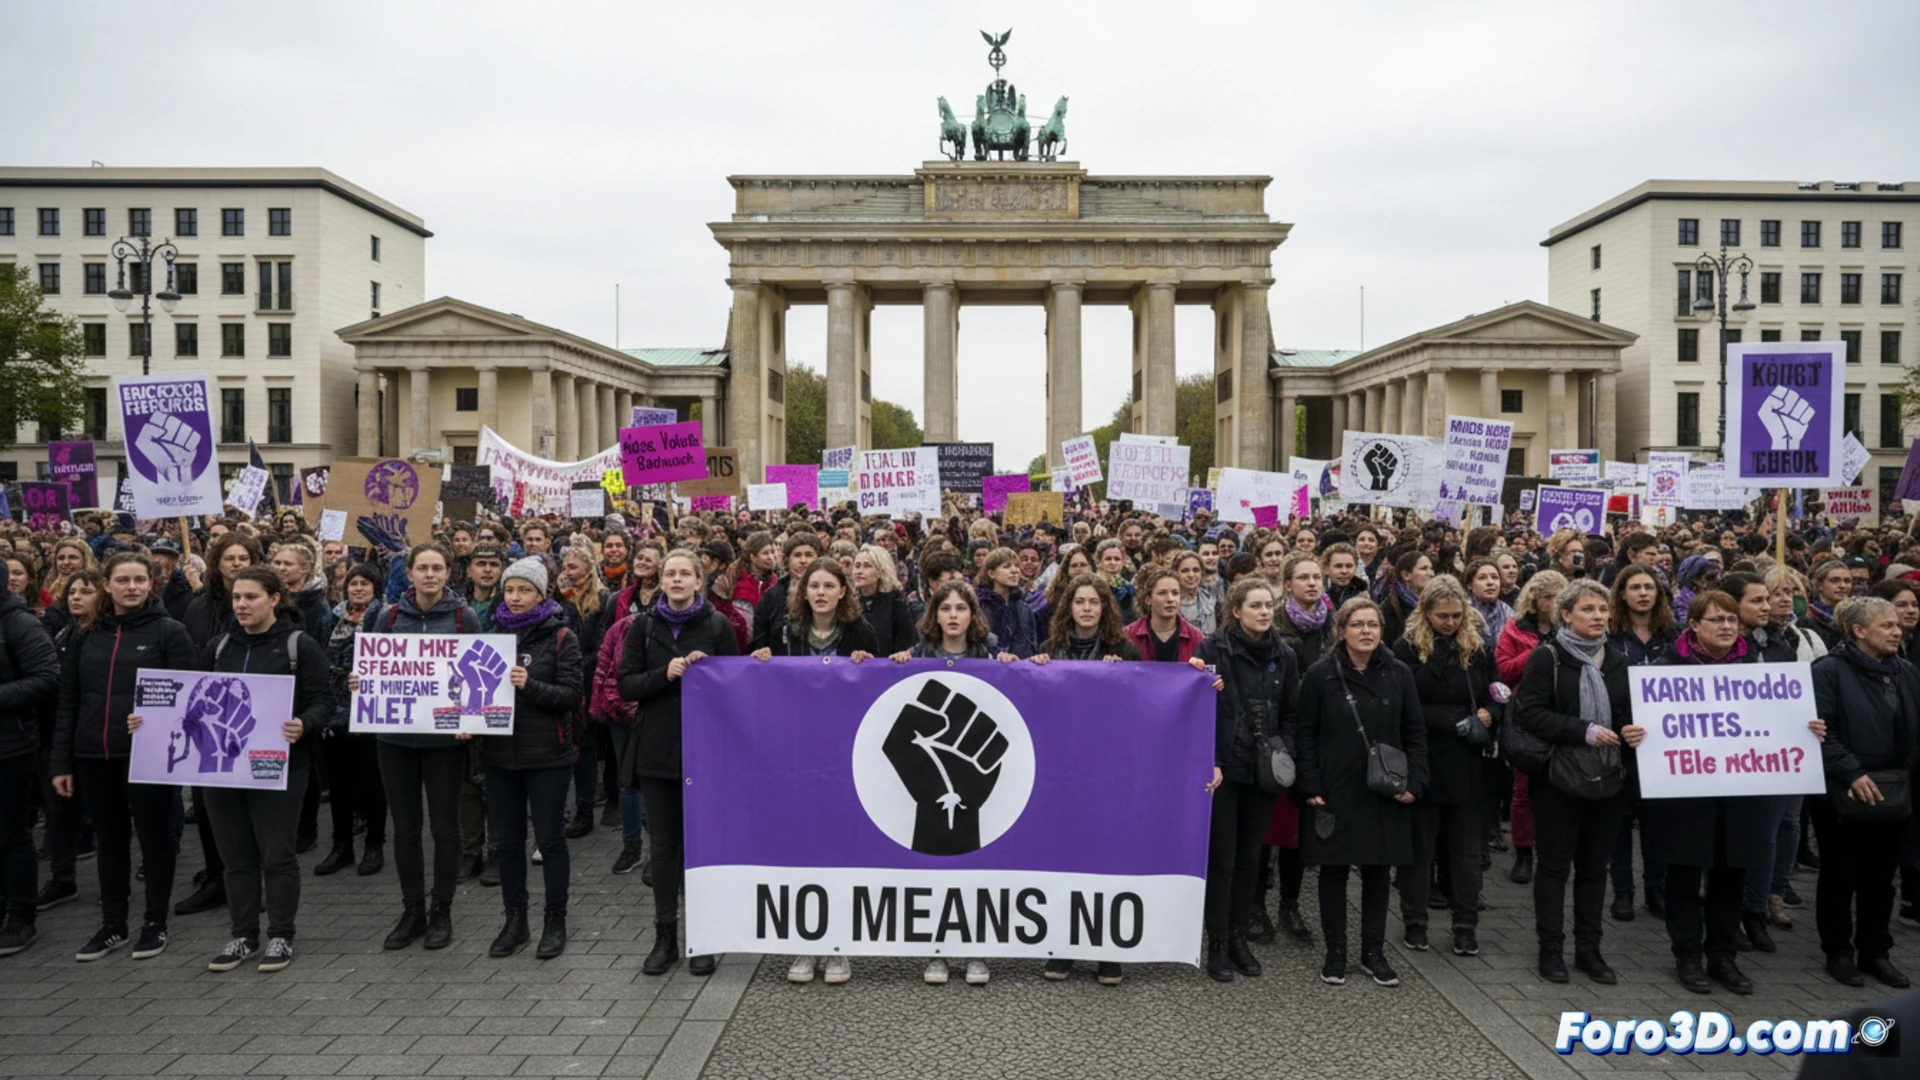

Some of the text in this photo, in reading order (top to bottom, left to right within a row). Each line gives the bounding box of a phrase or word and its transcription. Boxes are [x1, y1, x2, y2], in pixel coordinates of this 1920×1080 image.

[1641, 673, 1802, 702] KARN Hrodde
[756, 883, 1144, 949] NO MEANS NO
